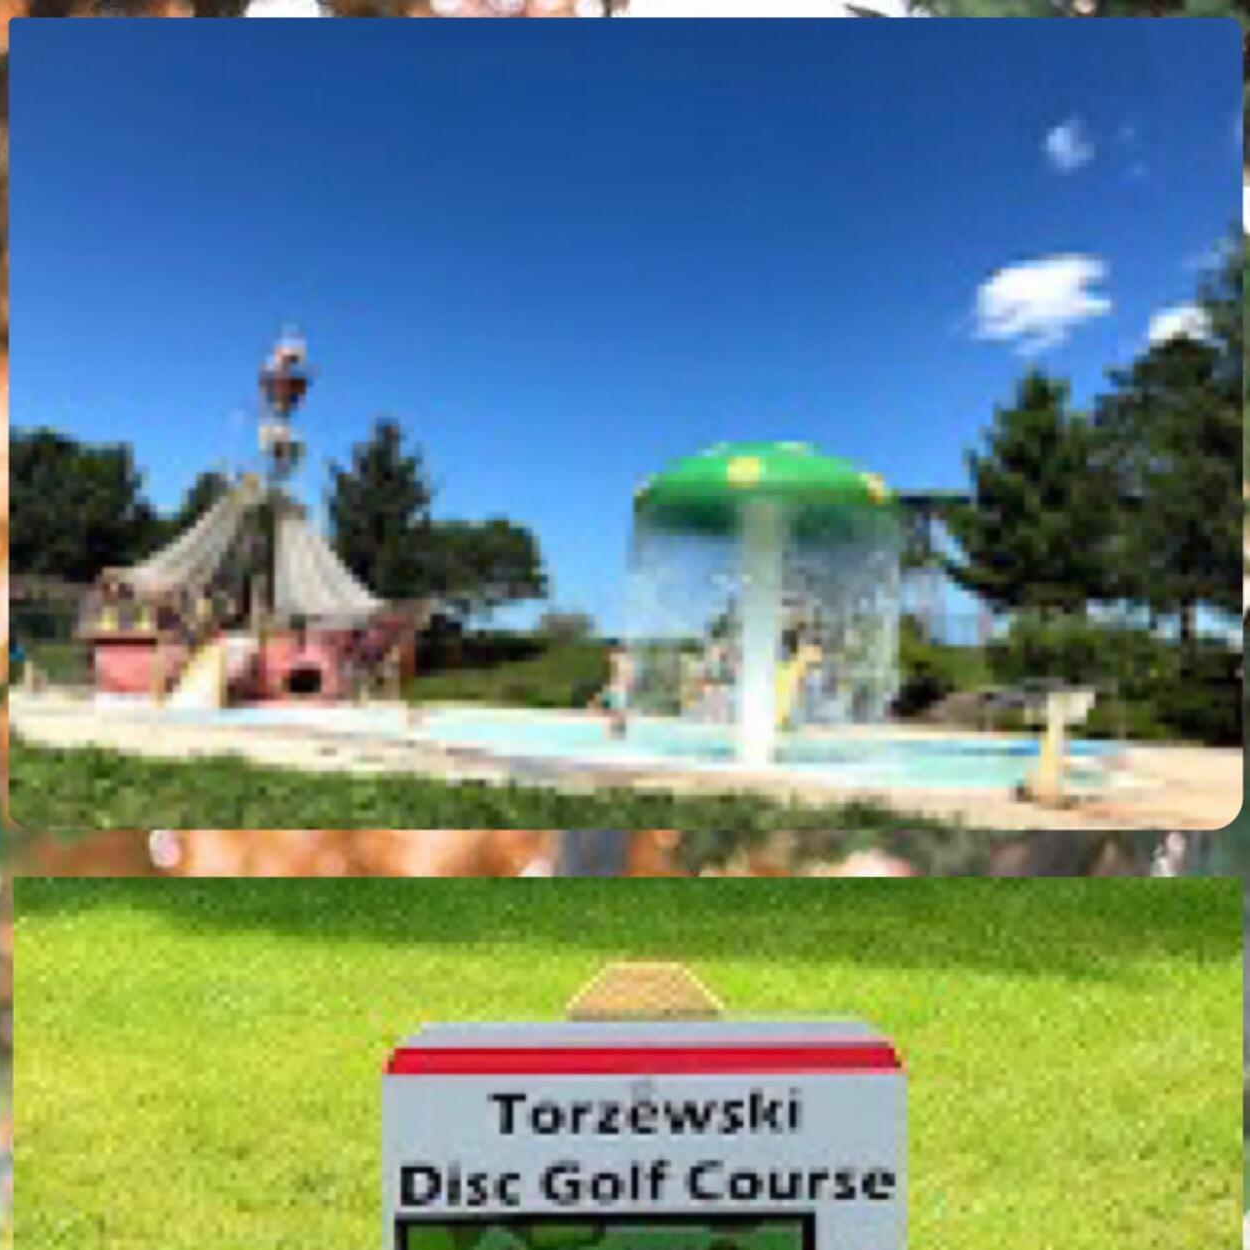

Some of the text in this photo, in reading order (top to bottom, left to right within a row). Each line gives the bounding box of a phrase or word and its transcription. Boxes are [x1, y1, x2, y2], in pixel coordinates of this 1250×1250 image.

[488, 1089, 803, 1135] Torzewski
[399, 1160, 897, 1206] Disc Golf Course
